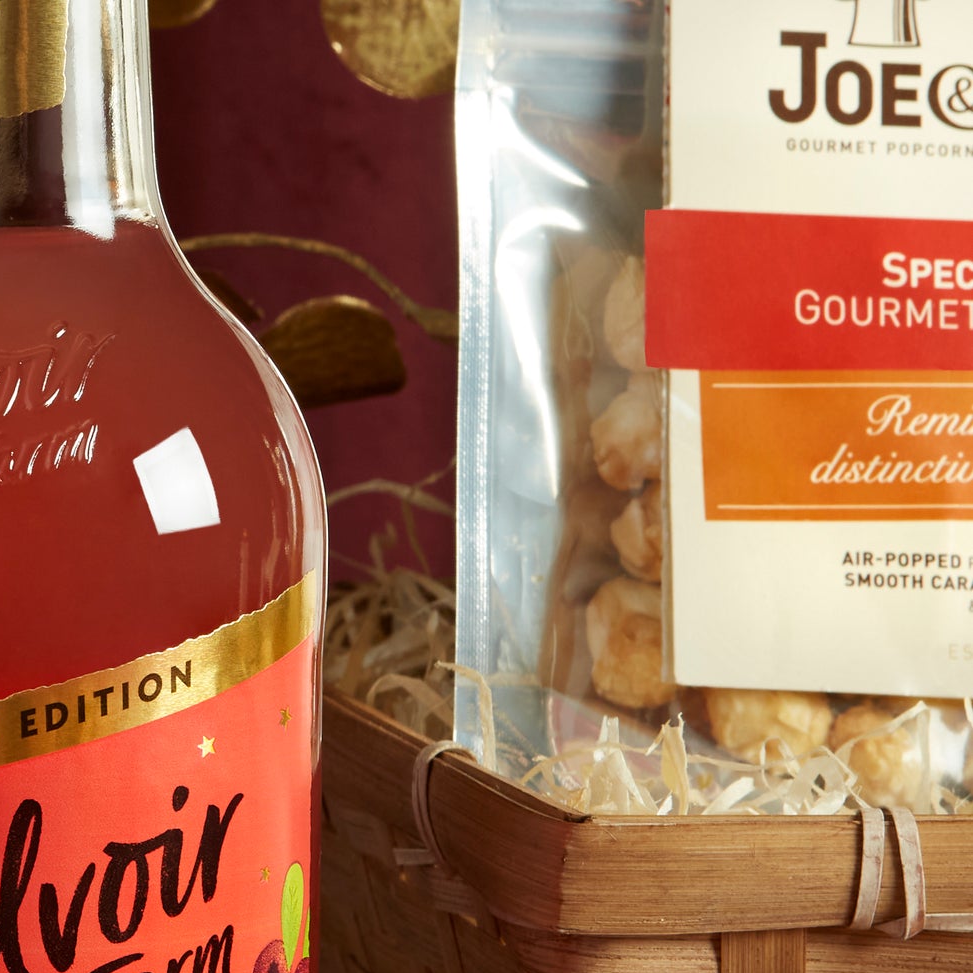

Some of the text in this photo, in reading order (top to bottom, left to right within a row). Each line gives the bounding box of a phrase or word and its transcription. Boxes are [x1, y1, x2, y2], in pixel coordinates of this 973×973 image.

[768, 31, 922, 128] JOE
[785, 137, 973, 158] GOURMET POPCORN
[882, 251, 973, 290] SPEC
[794, 288, 973, 331] GOURMET
[842, 551, 962, 569] AIR-POPPED
[845, 572, 924, 589] SMOOTH
[20, 659, 193, 739] EDITION
